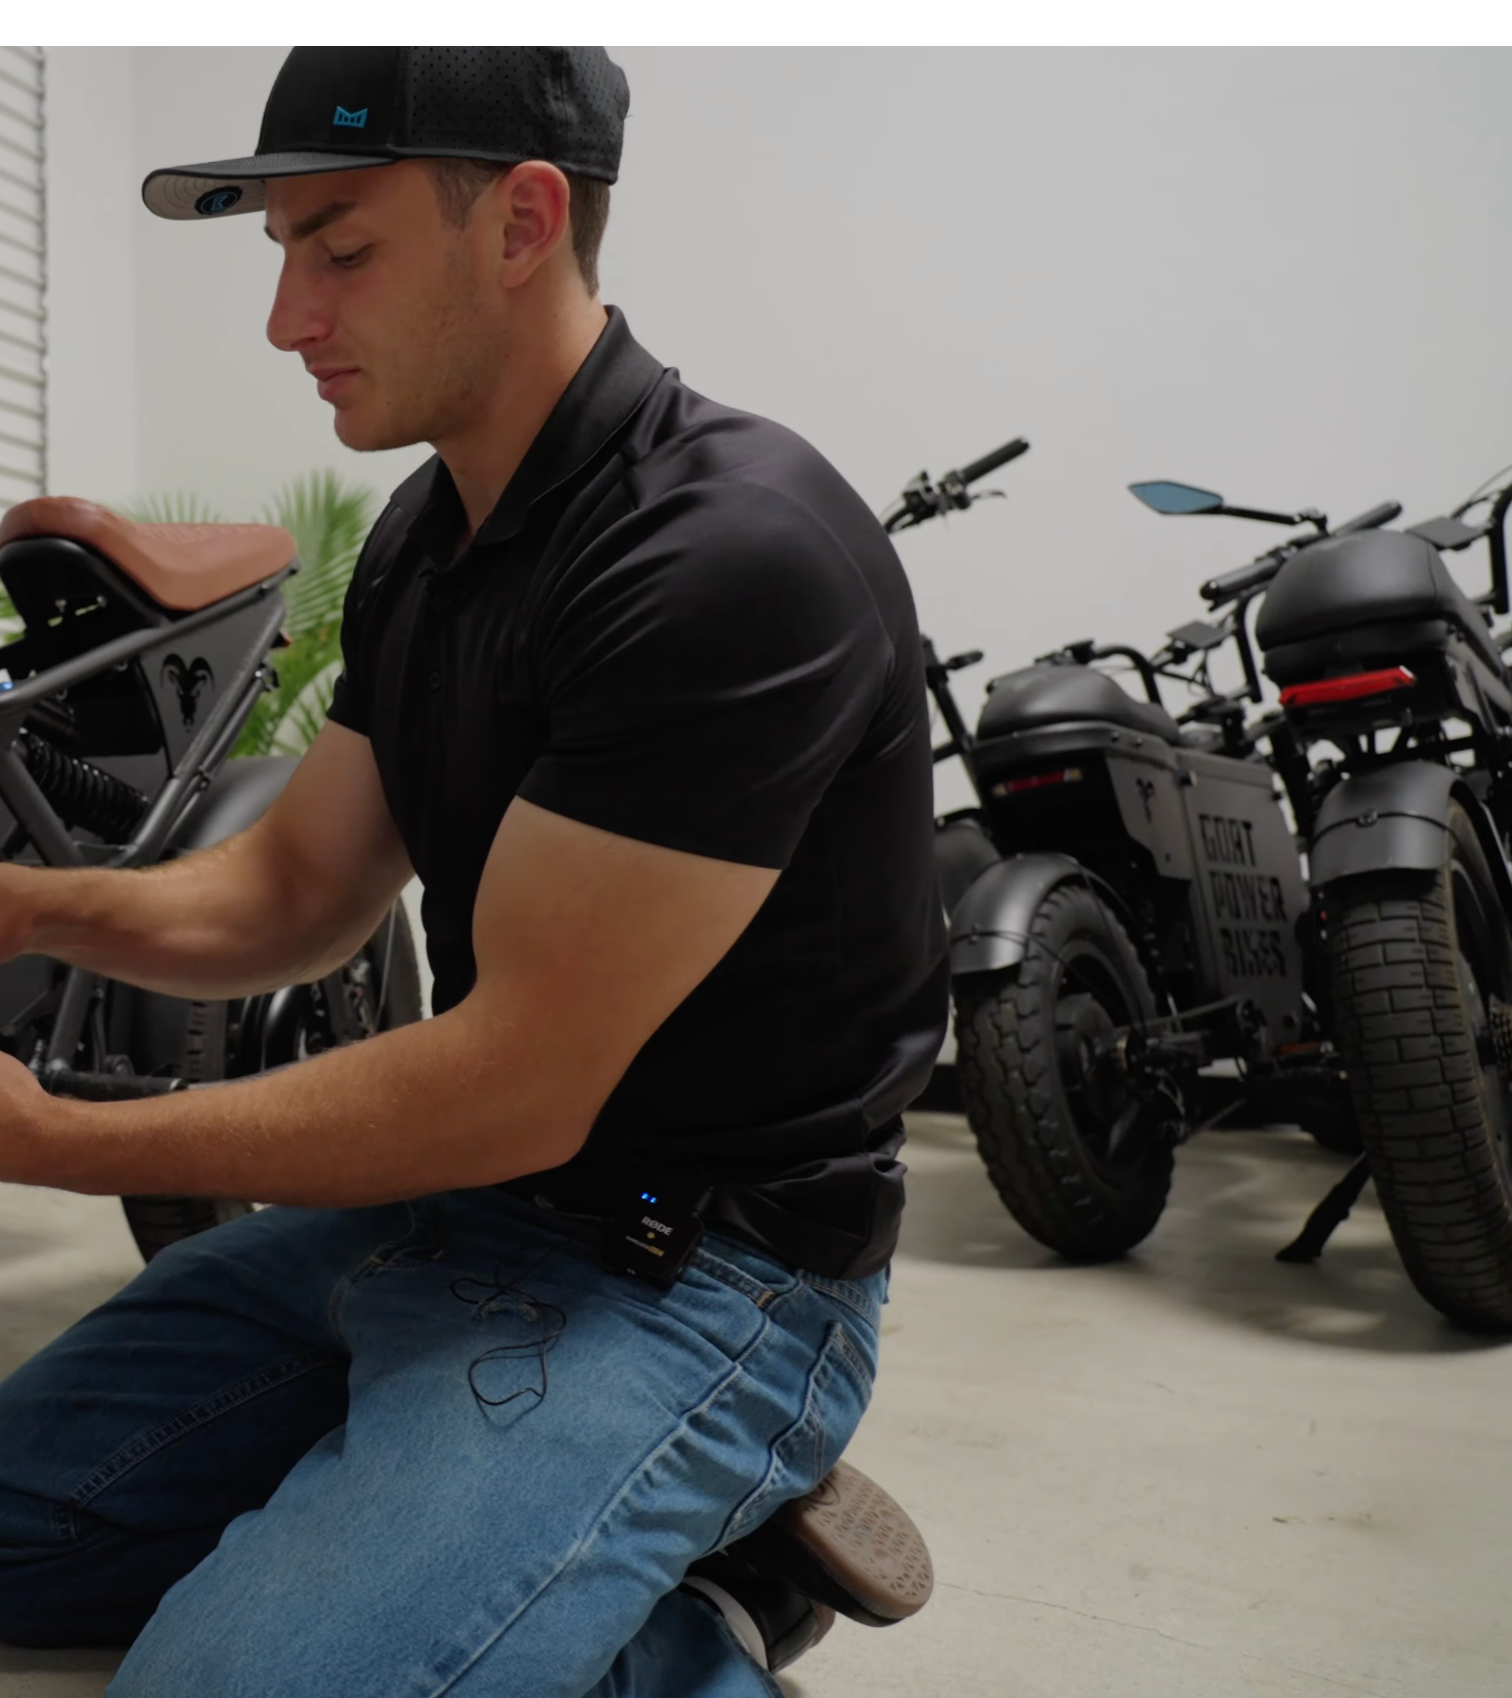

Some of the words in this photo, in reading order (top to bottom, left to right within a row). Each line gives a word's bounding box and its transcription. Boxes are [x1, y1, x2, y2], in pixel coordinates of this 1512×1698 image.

[1199, 814, 1256, 867] GOAT
[1209, 870, 1287, 922] POWER
[1219, 927, 1287, 977] BIKES
